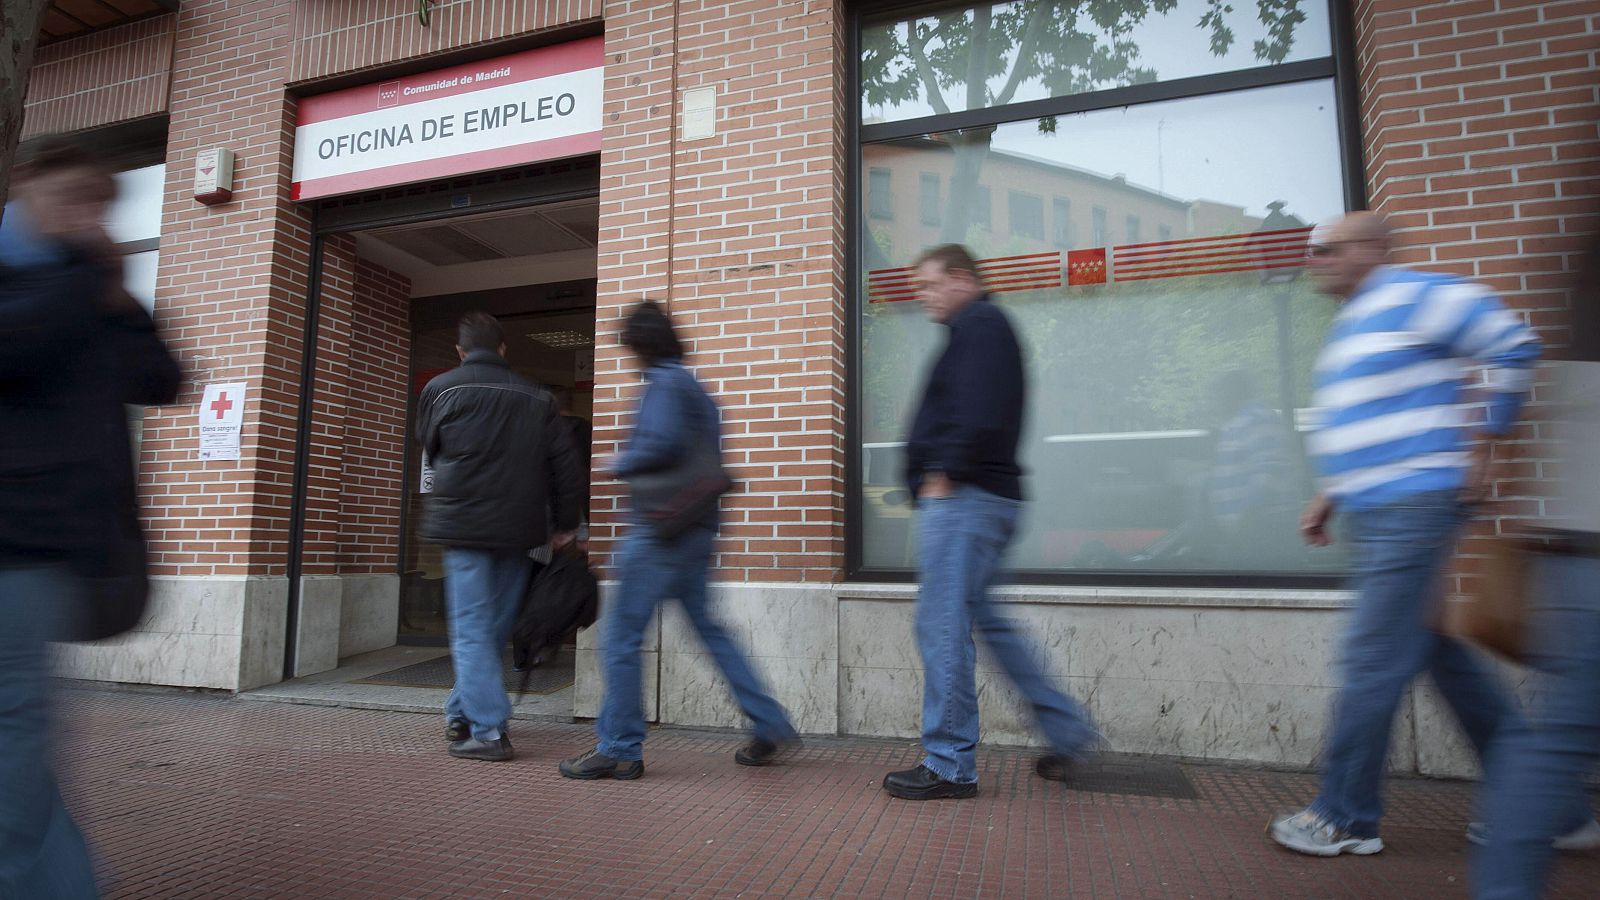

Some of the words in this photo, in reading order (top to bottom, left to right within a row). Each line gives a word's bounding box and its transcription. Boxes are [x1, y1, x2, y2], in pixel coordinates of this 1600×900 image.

[403, 78, 458, 96] Comunidad
[460, 74, 473, 86] de
[475, 67, 511, 82] Madrid
[318, 123, 414, 160] OFICINA
[421, 115, 455, 142] DE
[463, 92, 576, 134] EMPLEO
